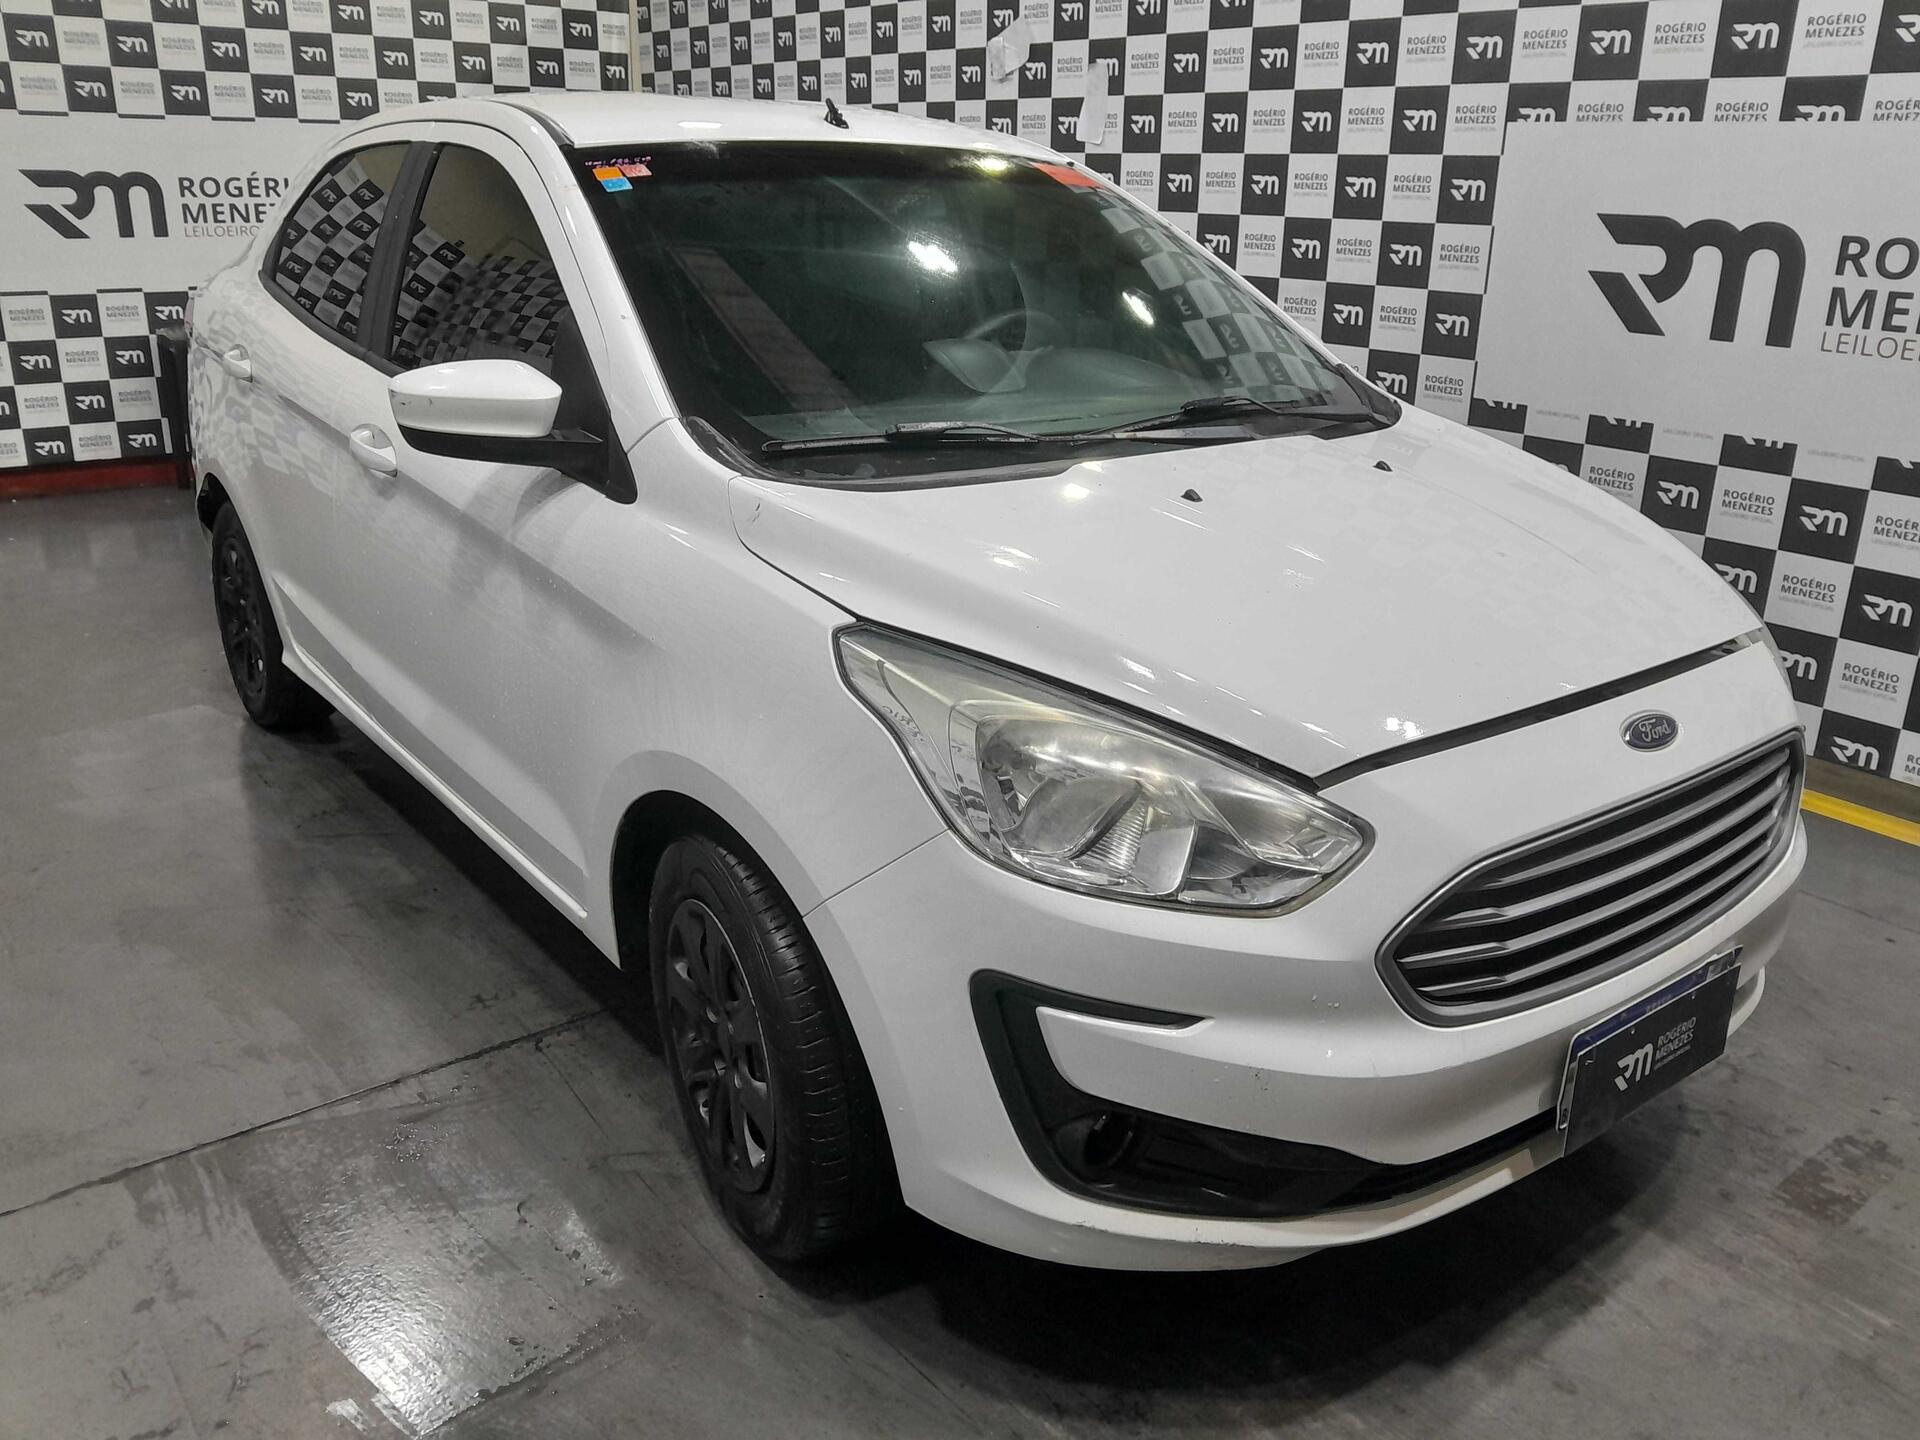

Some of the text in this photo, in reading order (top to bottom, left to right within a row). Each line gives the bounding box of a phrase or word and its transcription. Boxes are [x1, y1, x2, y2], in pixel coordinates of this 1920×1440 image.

[1807, 12, 1867, 26] ROGÉRIO
[1655, 22, 1707, 34] ROGÉRIO
[1805, 25, 1865, 39] MENEZES
[1524, 28, 1568, 40] ROGÉRIO
[1654, 33, 1705, 45] MENEZES
[1304, 41, 1339, 51] ROGÉRIO
[1407, 35, 1447, 46] ROGÉRIO
[1522, 39, 1567, 50] MENEZES
[1213, 47, 1244, 56] ROGÉRIO
[1406, 45, 1446, 55] MENEZES
[1213, 56, 1244, 65] MENEZES
[1304, 51, 1339, 61] MENEZES
[1348, 106, 1385, 116] ROGÉRIO
[1455, 104, 1497, 115] ROGÉRIO
[1577, 103, 1624, 113] ROGÉRIO
[1716, 101, 1769, 113] ROGÉRIO
[1168, 110, 1198, 119] ROGÉRIO
[1253, 108, 1286, 118] ROGÉRIO
[1168, 119, 1198, 128] MENEZES
[1252, 117, 1286, 126] MENEZES
[1348, 116, 1384, 126] MENEZES
[1454, 114, 1497, 125] MENEZES
[1206, 170, 1237, 180] ROGÉRIO
[1294, 172, 1328, 182] ROGÉRIO
[1394, 174, 1431, 184] ROGÉRIO
[1205, 179, 1236, 188] MENEZES
[1294, 181, 1328, 191] MENEZES
[1393, 183, 1431, 193] MENEZES
[182, 203, 276, 224] MENE
[1245, 233, 1276, 243] ROGÉRIO
[1337, 237, 1372, 248] ROGÉRIO
[1244, 241, 1275, 251] MENEZES
[1440, 243, 1480, 254] ROGÉRIO
[1336, 247, 1372, 257] MENEZES
[1439, 253, 1480, 264] MENEZES
[1284, 297, 1317, 307] ROGÉRIO
[1283, 305, 1317, 316] MENEZES
[1380, 305, 1417, 316] ROGÉRIO
[1824, 286, 1920, 333] ME
[1379, 314, 1416, 325] MENEZES
[1821, 331, 1920, 361] LEILOE
[1425, 375, 1464, 387] ROGÉRIO
[1424, 384, 1463, 396] MENEZES
[1590, 465, 1635, 481] ROGÉRIO
[1723, 489, 1775, 506] ROGÉRIO
[1721, 499, 1773, 516] MENEZES
[1873, 526, 1920, 542] MENEZ
[1783, 574, 1837, 592] ROGÉRIO
[1780, 585, 1835, 602] MENEZES
[1844, 663, 1900, 683] ROGÉRIO
[1842, 673, 1898, 694] MENEZES
[1639, 718, 1671, 742] Ford
